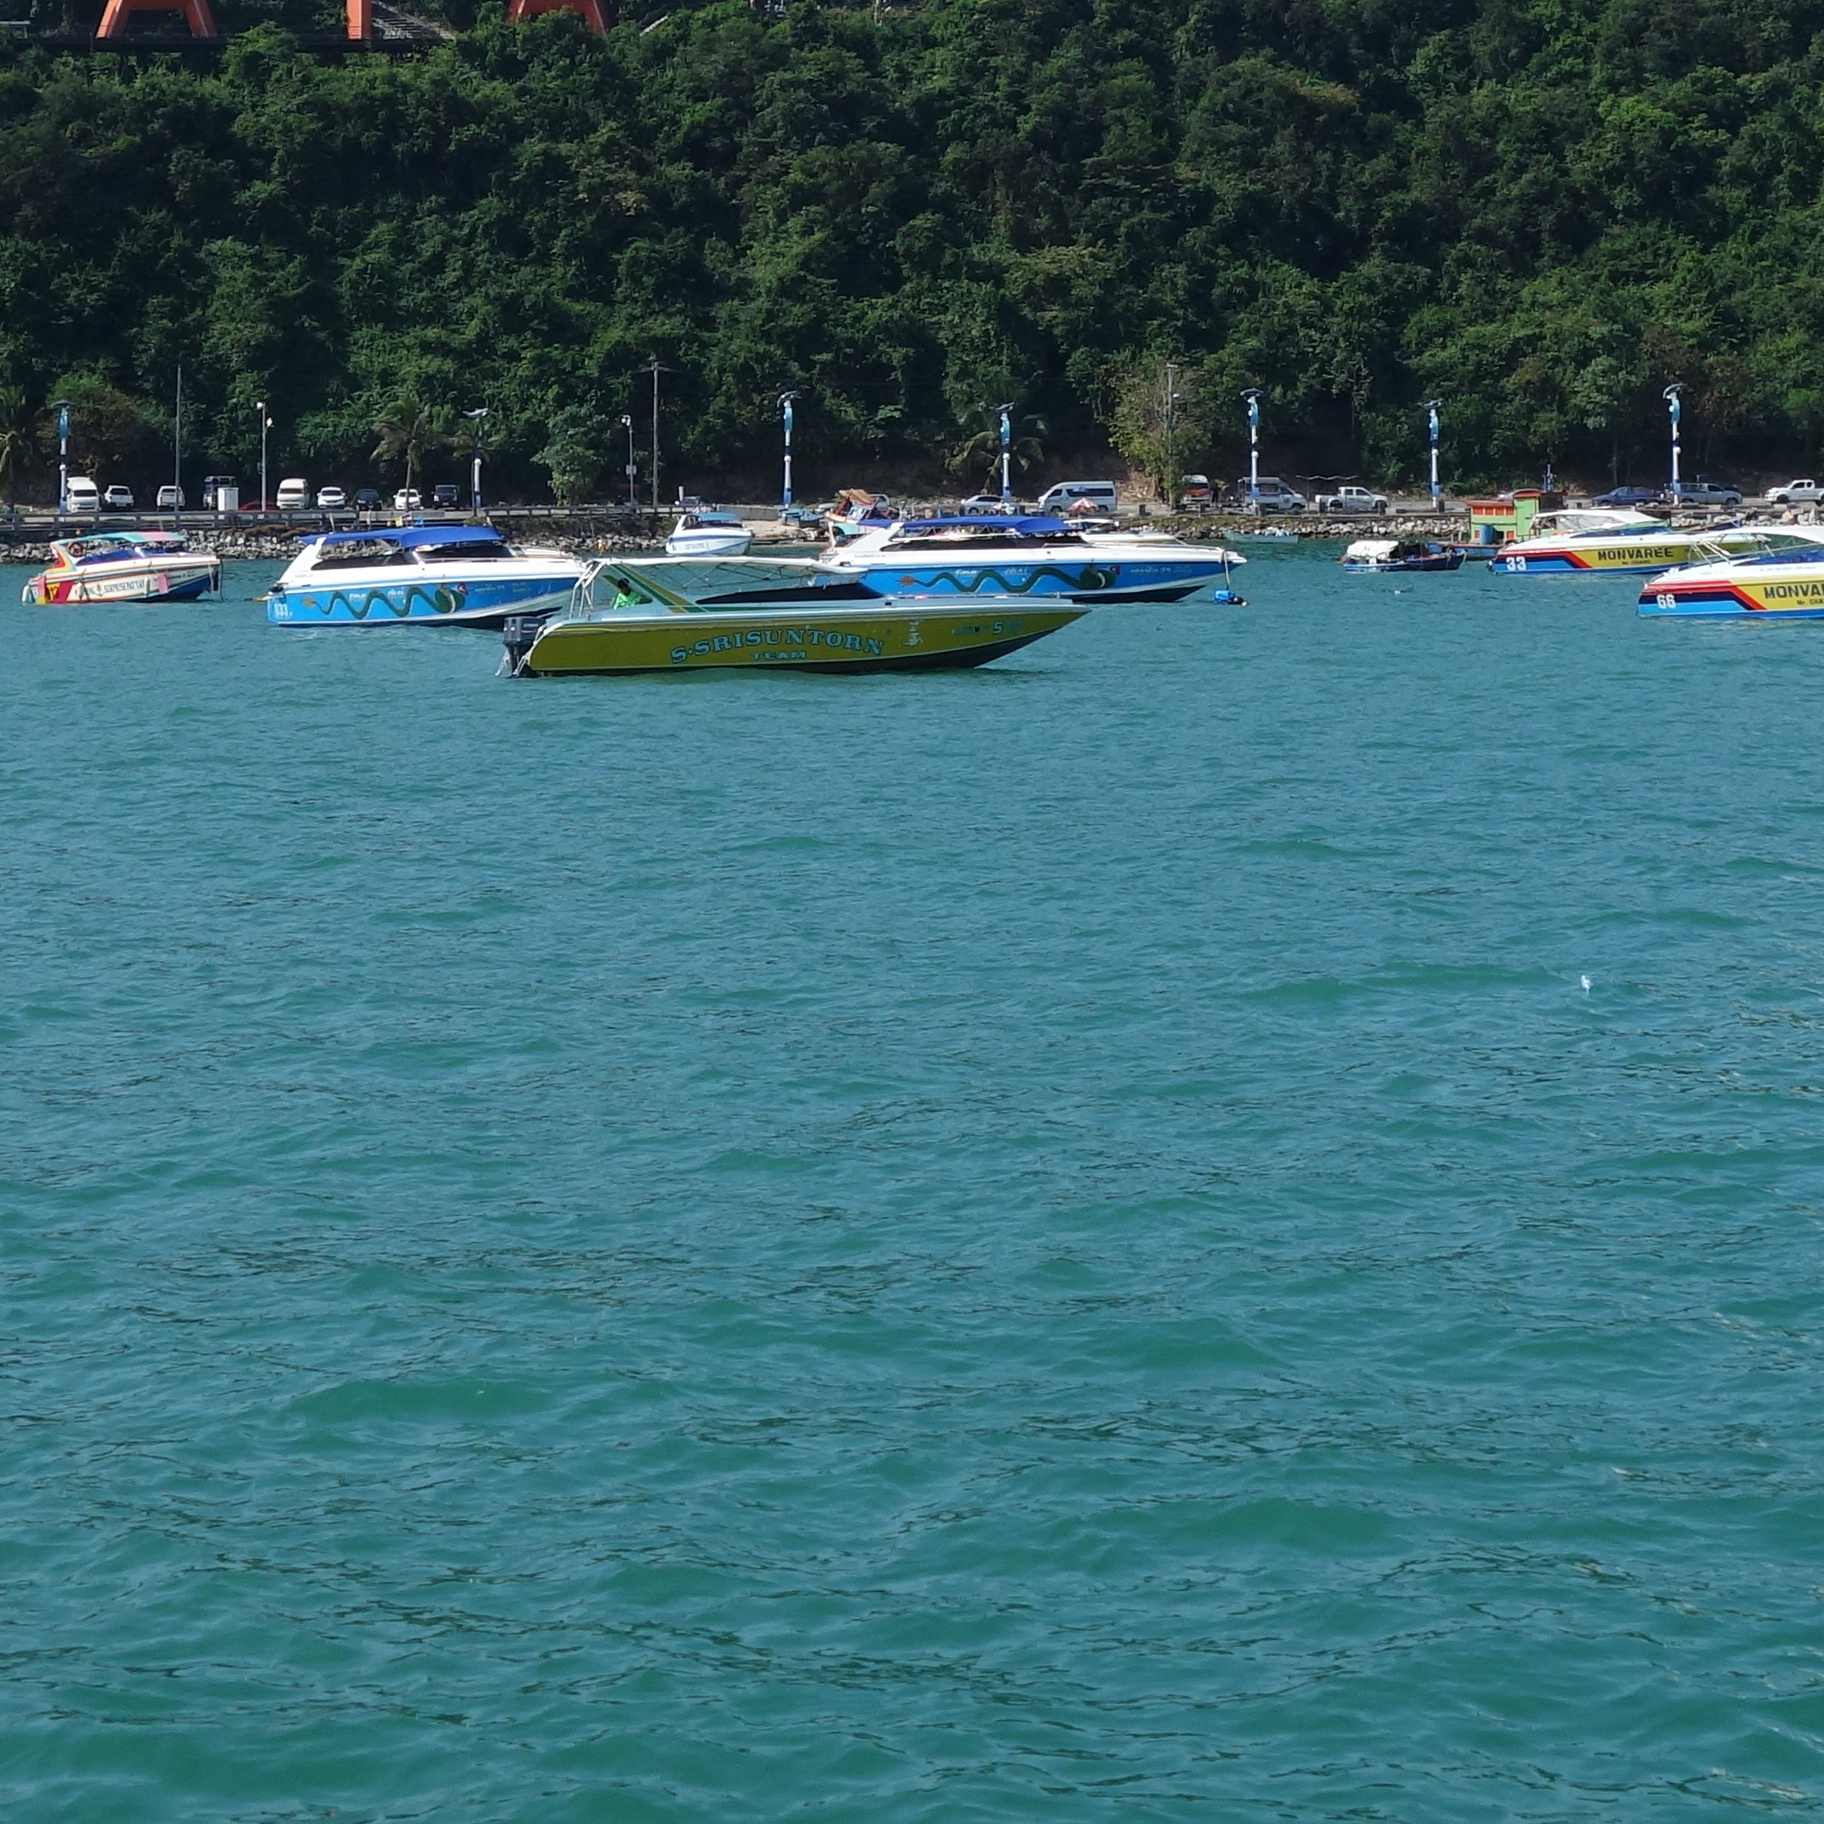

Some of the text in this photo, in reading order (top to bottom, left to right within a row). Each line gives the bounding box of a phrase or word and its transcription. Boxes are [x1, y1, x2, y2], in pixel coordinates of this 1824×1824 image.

[1597, 547, 1674, 561] MONVAREE
[1505, 556, 1526, 571] 33
[1656, 593, 1676, 609] 66
[752, 651, 807, 661] TEAM
